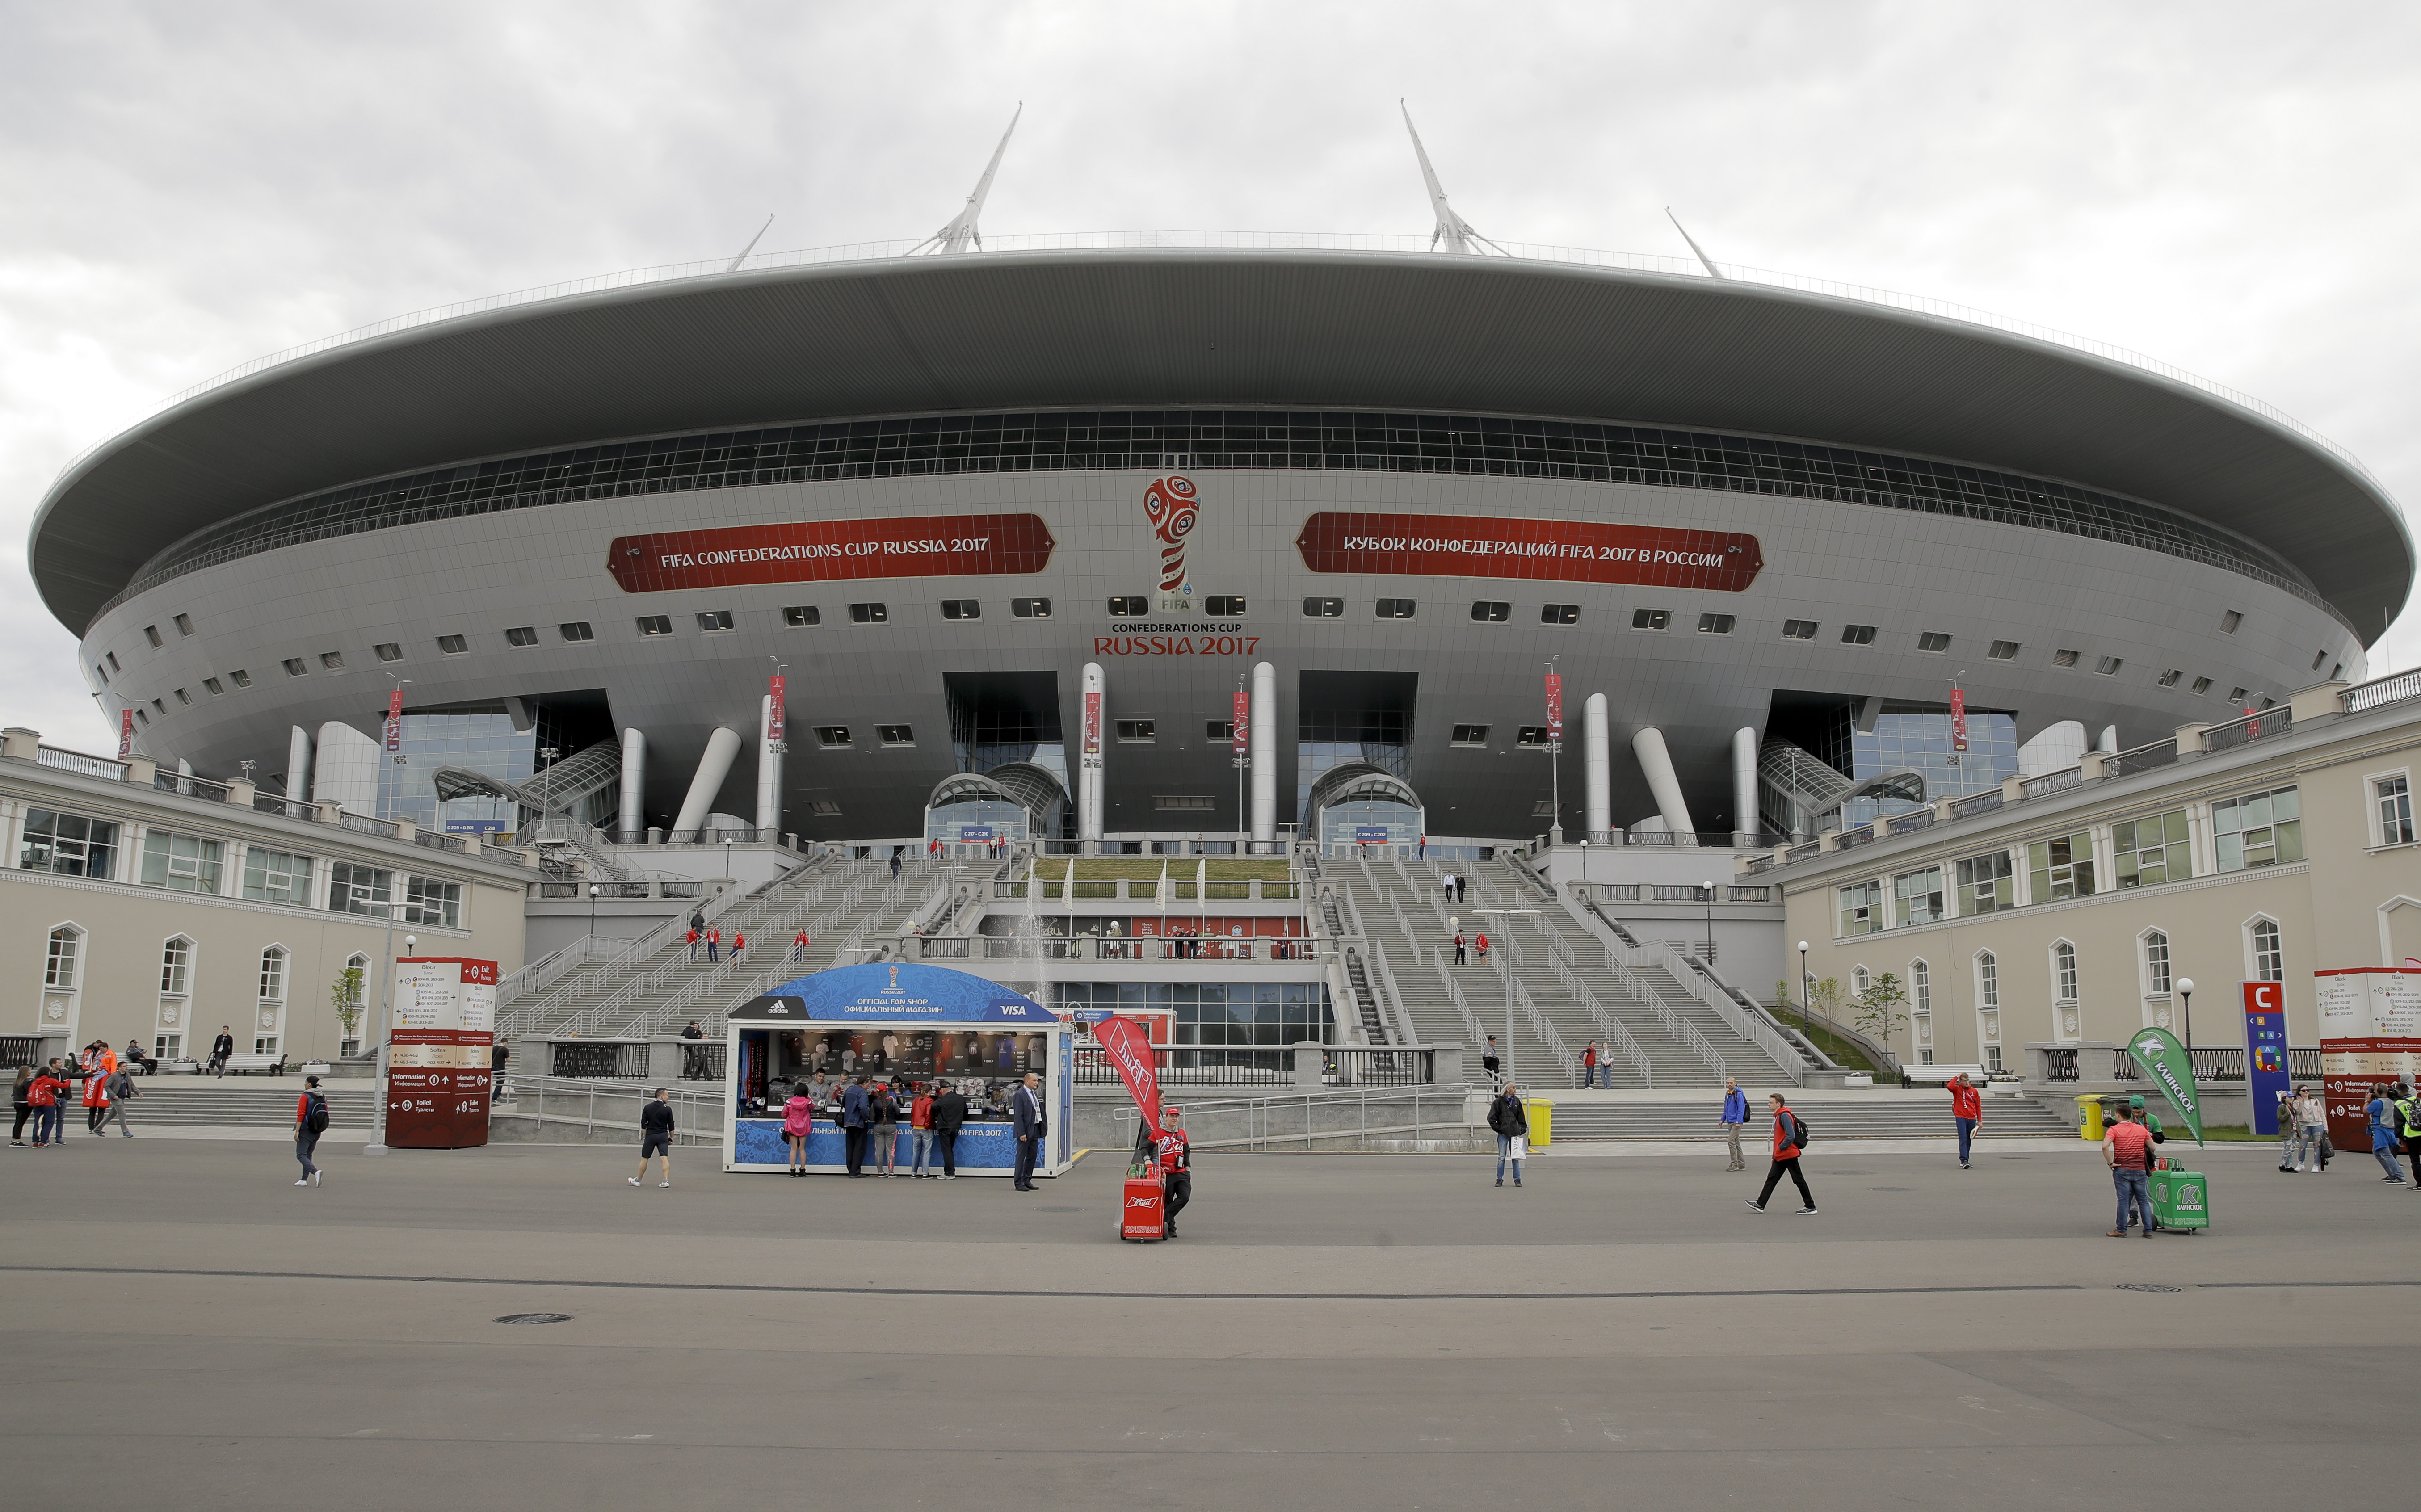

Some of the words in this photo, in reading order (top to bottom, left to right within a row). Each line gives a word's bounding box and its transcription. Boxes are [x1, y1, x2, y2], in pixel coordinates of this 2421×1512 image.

[661, 554, 695, 568] FIFA
[697, 543, 842, 565] CONFEDERATIONS
[845, 542, 879, 556] CUP
[883, 539, 947, 554] RUSSIA
[951, 538, 988, 552] 2017
[1344, 536, 1406, 551] КУБОК
[1410, 538, 1556, 558] КОНФЕДЕРАЦИЙ
[1560, 544, 1595, 559] FIFA
[1598, 547, 1637, 561] 2017
[1639, 550, 1650, 562] В
[1653, 550, 1723, 567] РОССИИ
[1162, 600, 1189, 609] FIFA
[1112, 624, 1215, 632] CONFEDERATIONS
[1219, 624, 1242, 632] CUP
[1094, 636, 1195, 655] RUSSIA
[1199, 636, 1261, 655] 2017
[2255, 987, 2271, 1008] C
[1000, 1006, 1026, 1015] VISA
[2155, 1062, 2195, 1113] КЛИНСКОЕ
